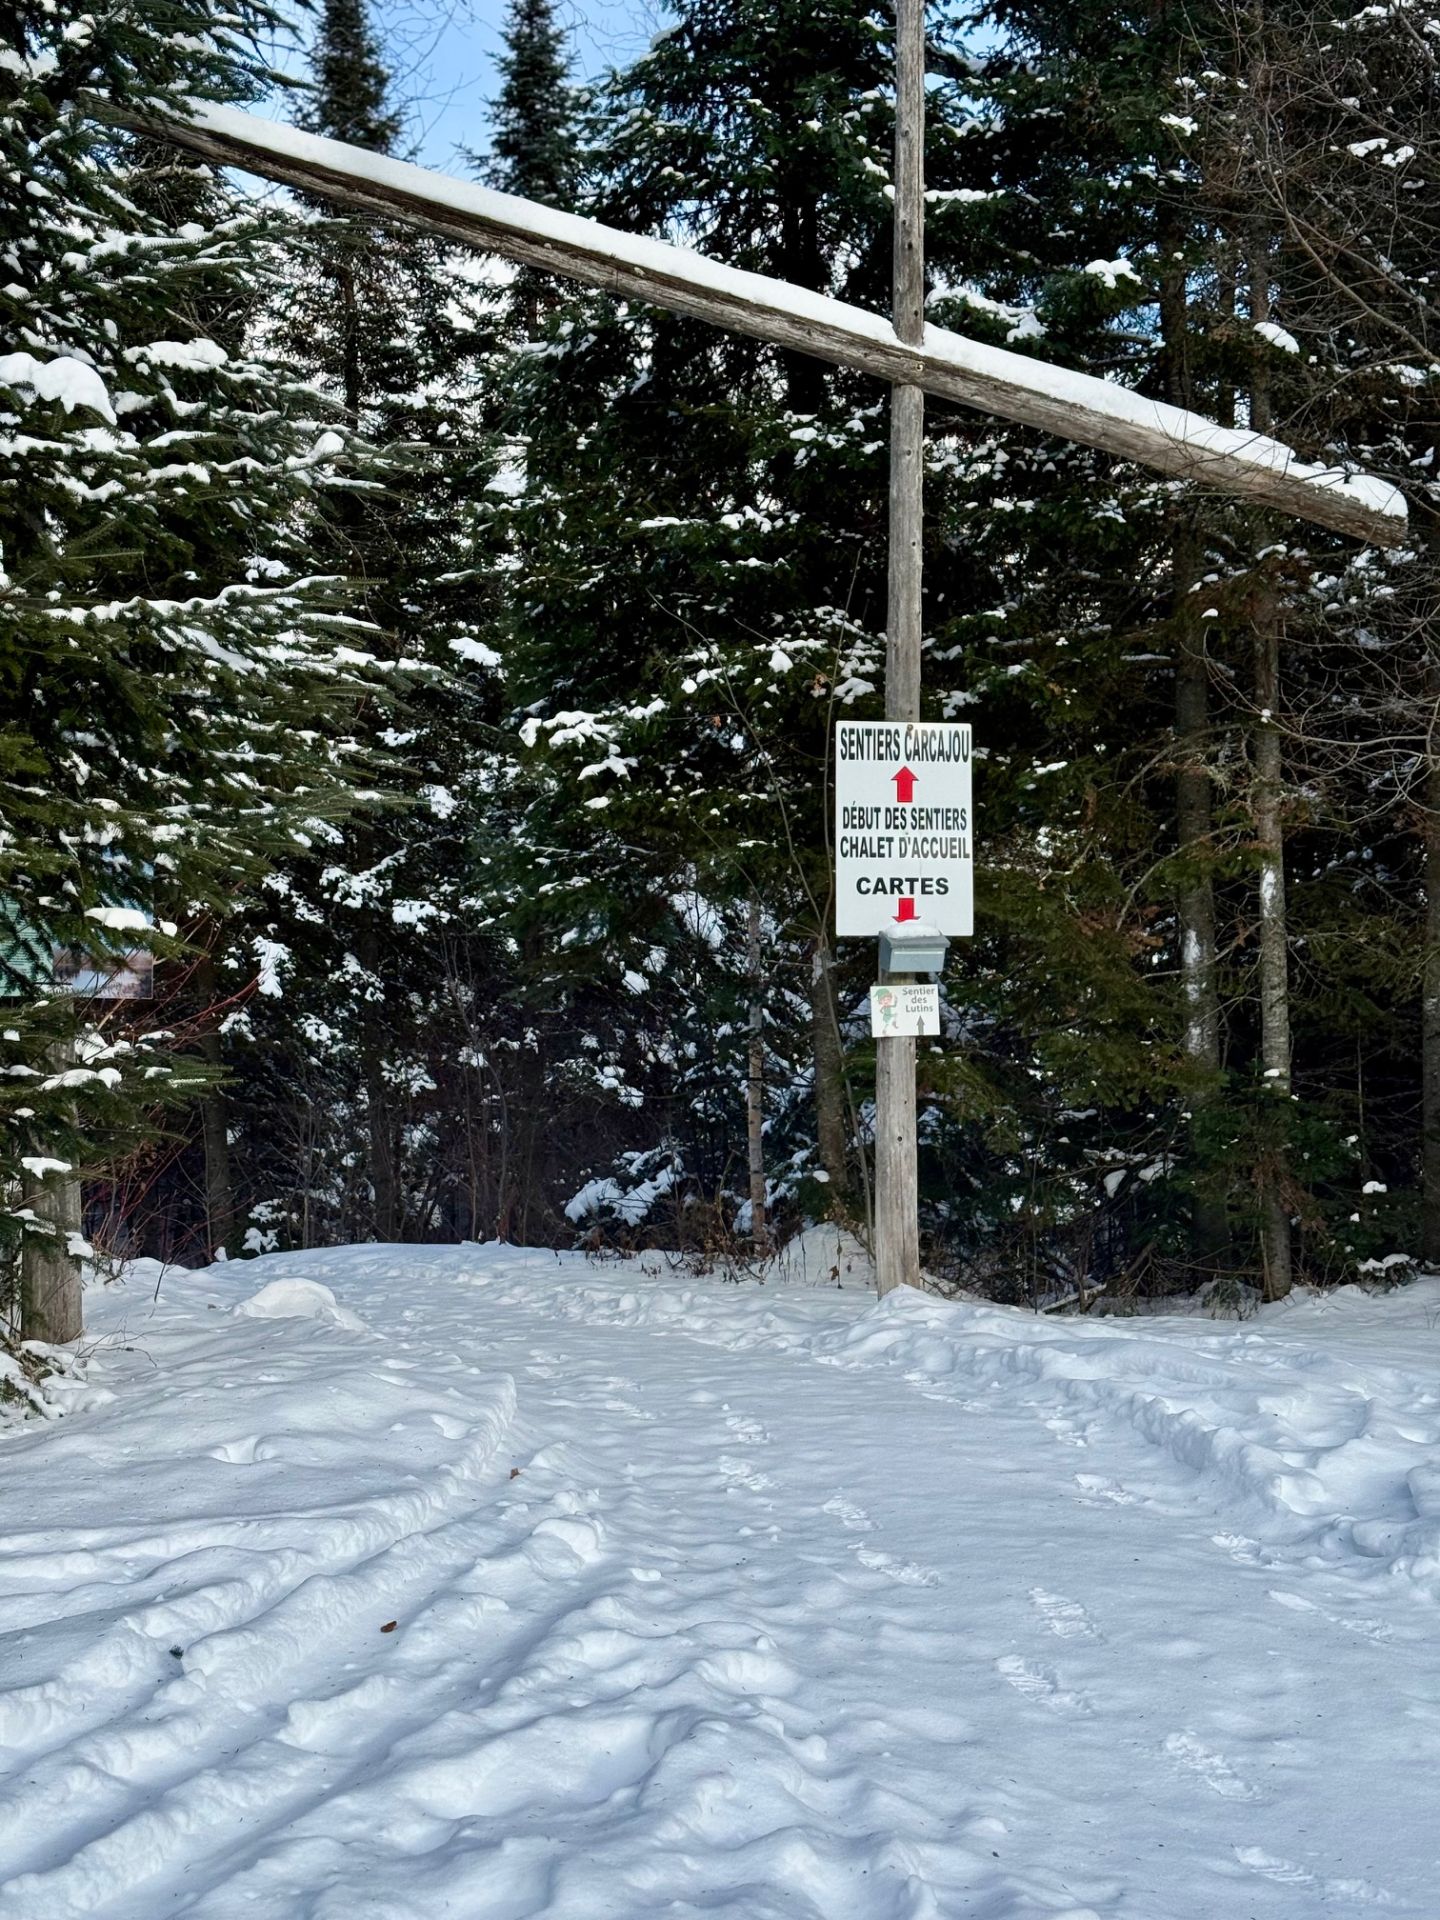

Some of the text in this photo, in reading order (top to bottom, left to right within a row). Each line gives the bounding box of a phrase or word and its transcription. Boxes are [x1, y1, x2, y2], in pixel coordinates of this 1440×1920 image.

[840, 727, 970, 763] SENTIERS CARCAJOU
[842, 801, 967, 831] DÉBUT DES SENTIERS
[840, 836, 970, 859] CHALET D'ACCUEIL
[856, 877, 949, 896] CARTES
[902, 987, 935, 995] Sentier
[911, 995, 928, 1003] des
[905, 1004, 934, 1012] Lutins
